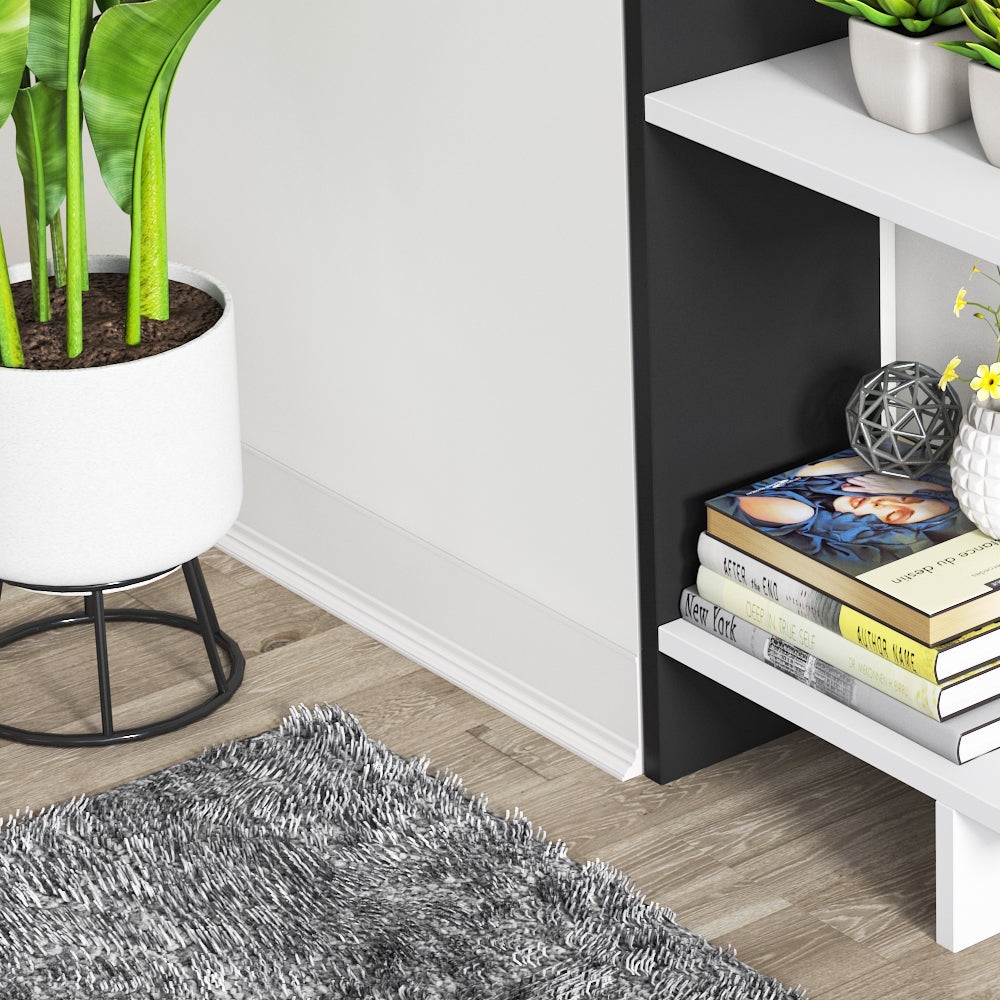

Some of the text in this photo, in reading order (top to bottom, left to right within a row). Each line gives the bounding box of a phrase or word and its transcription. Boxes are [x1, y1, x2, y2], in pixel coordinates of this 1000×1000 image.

[723, 557, 748, 586] AFTER
[763, 576, 779, 601] END
[890, 564, 934, 585] destin
[937, 556, 956, 568] du
[685, 593, 709, 627] New
[713, 605, 737, 642] York
[857, 625, 917, 672] AUTHOR NAME
